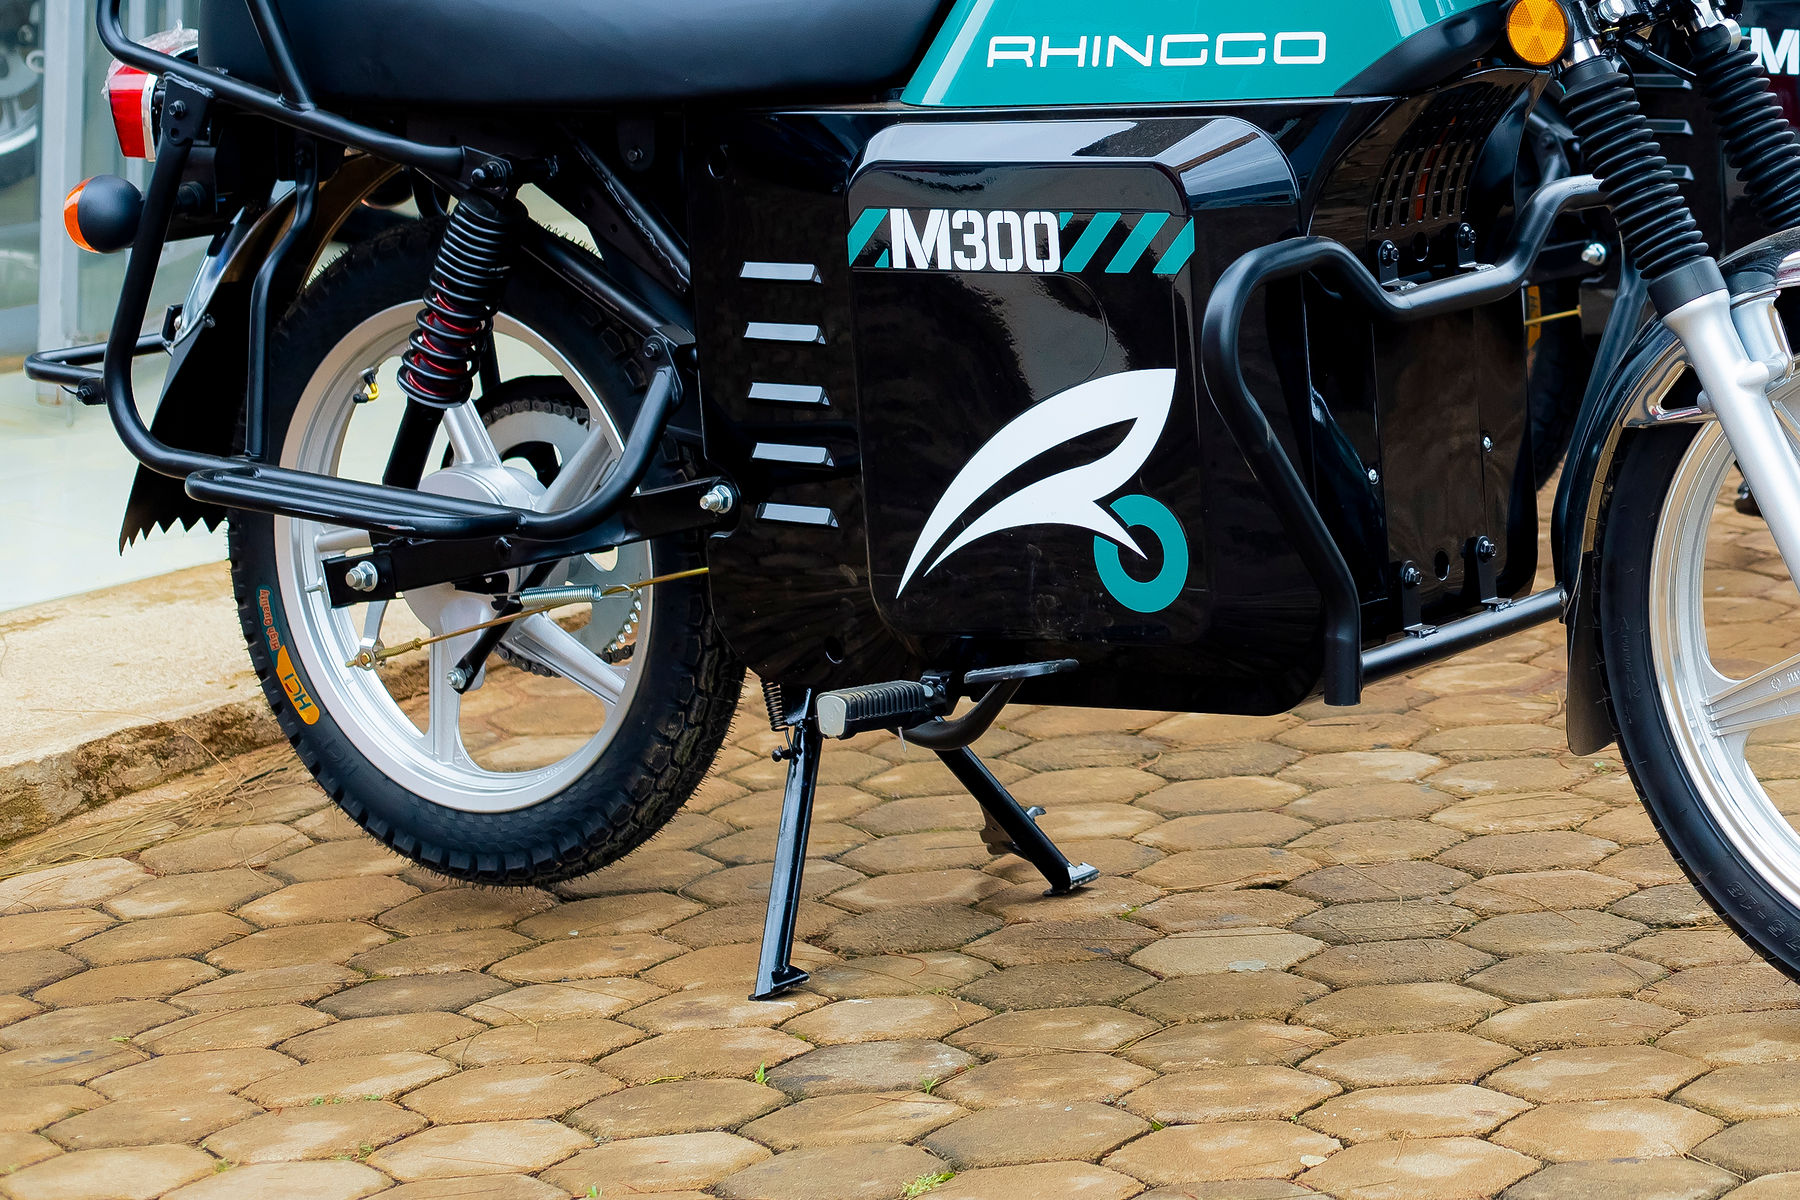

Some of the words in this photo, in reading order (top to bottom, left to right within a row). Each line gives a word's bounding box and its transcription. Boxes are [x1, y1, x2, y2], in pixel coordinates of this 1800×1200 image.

[987, 31, 1327, 68] RHINGGO
[890, 208, 1061, 273] M300
[259, 589, 274, 627] Quality
[266, 626, 281, 650] High
